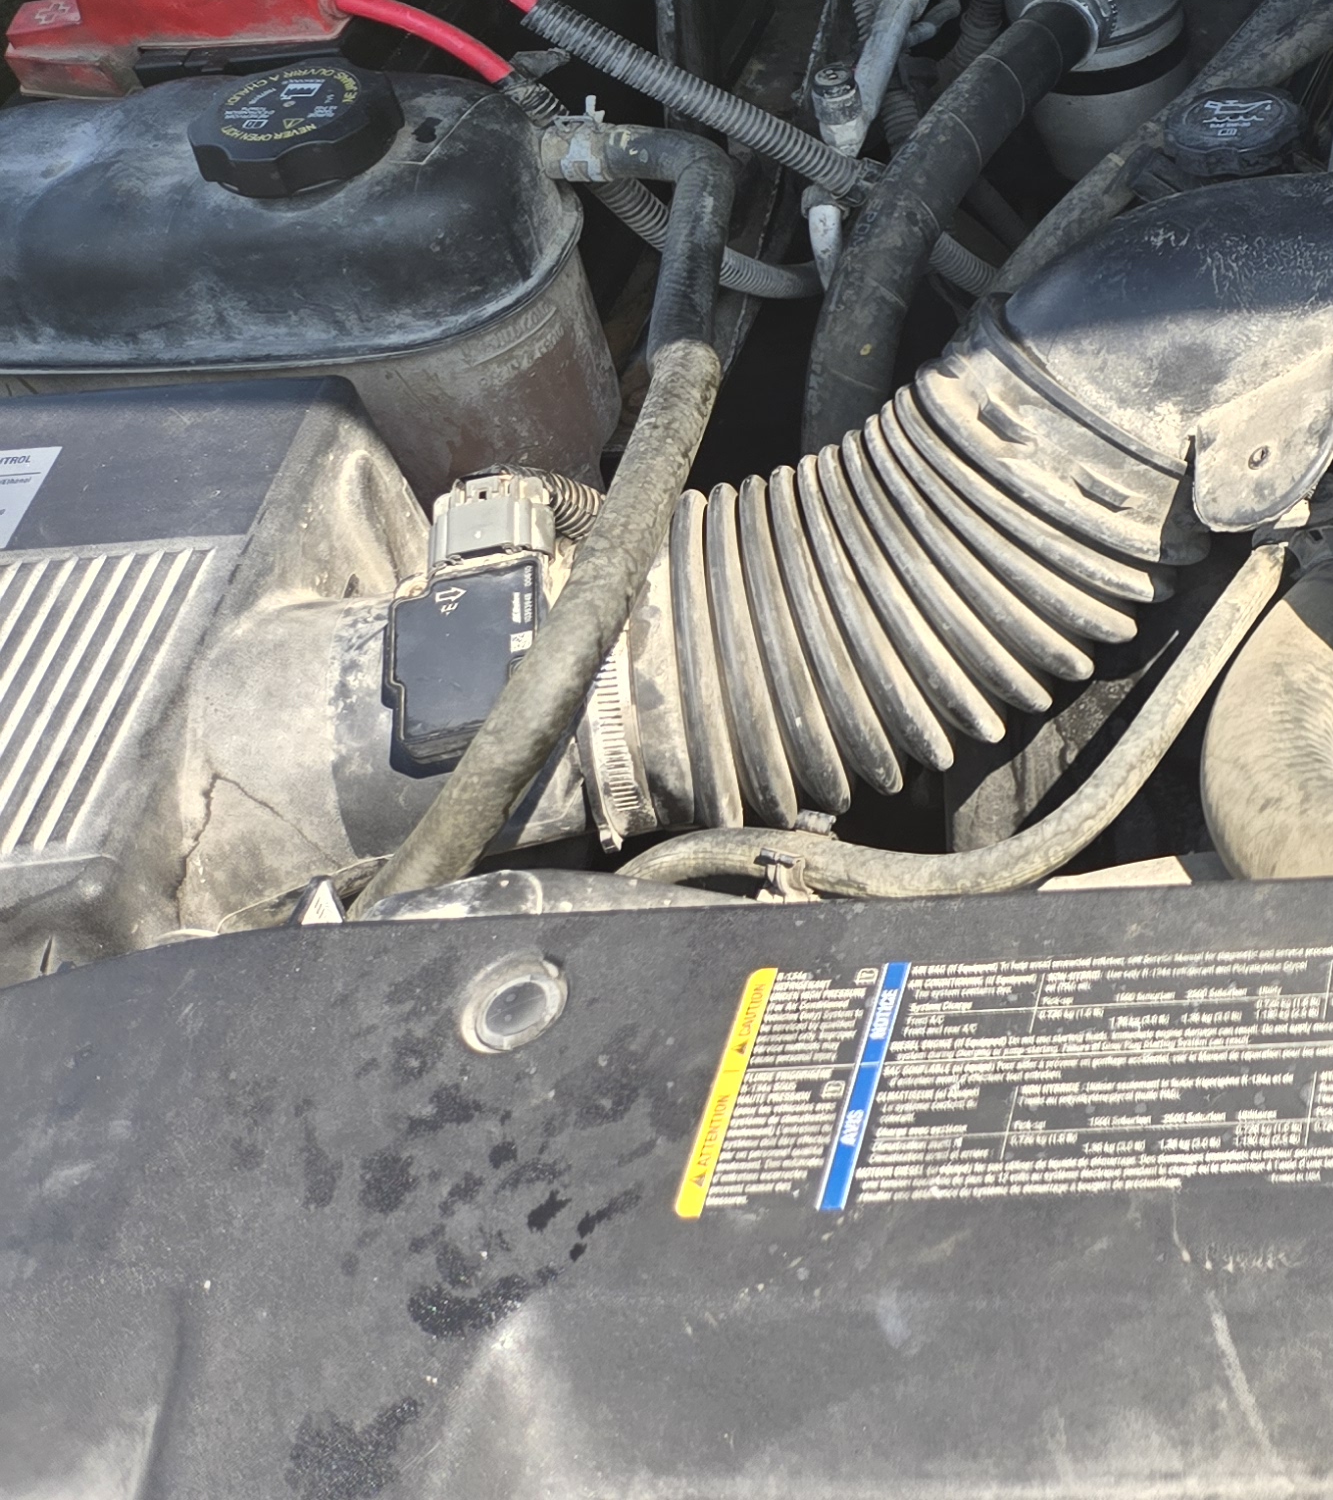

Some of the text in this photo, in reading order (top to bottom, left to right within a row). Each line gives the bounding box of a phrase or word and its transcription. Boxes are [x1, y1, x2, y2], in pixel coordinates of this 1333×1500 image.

[242, 131, 275, 141] OPEN
[273, 123, 317, 141] NEVER
[739, 983, 767, 1037] CAUTION
[869, 988, 899, 1041] NOTICE
[697, 1094, 731, 1167] ATTENTION
[840, 1109, 864, 1147] AVIS
